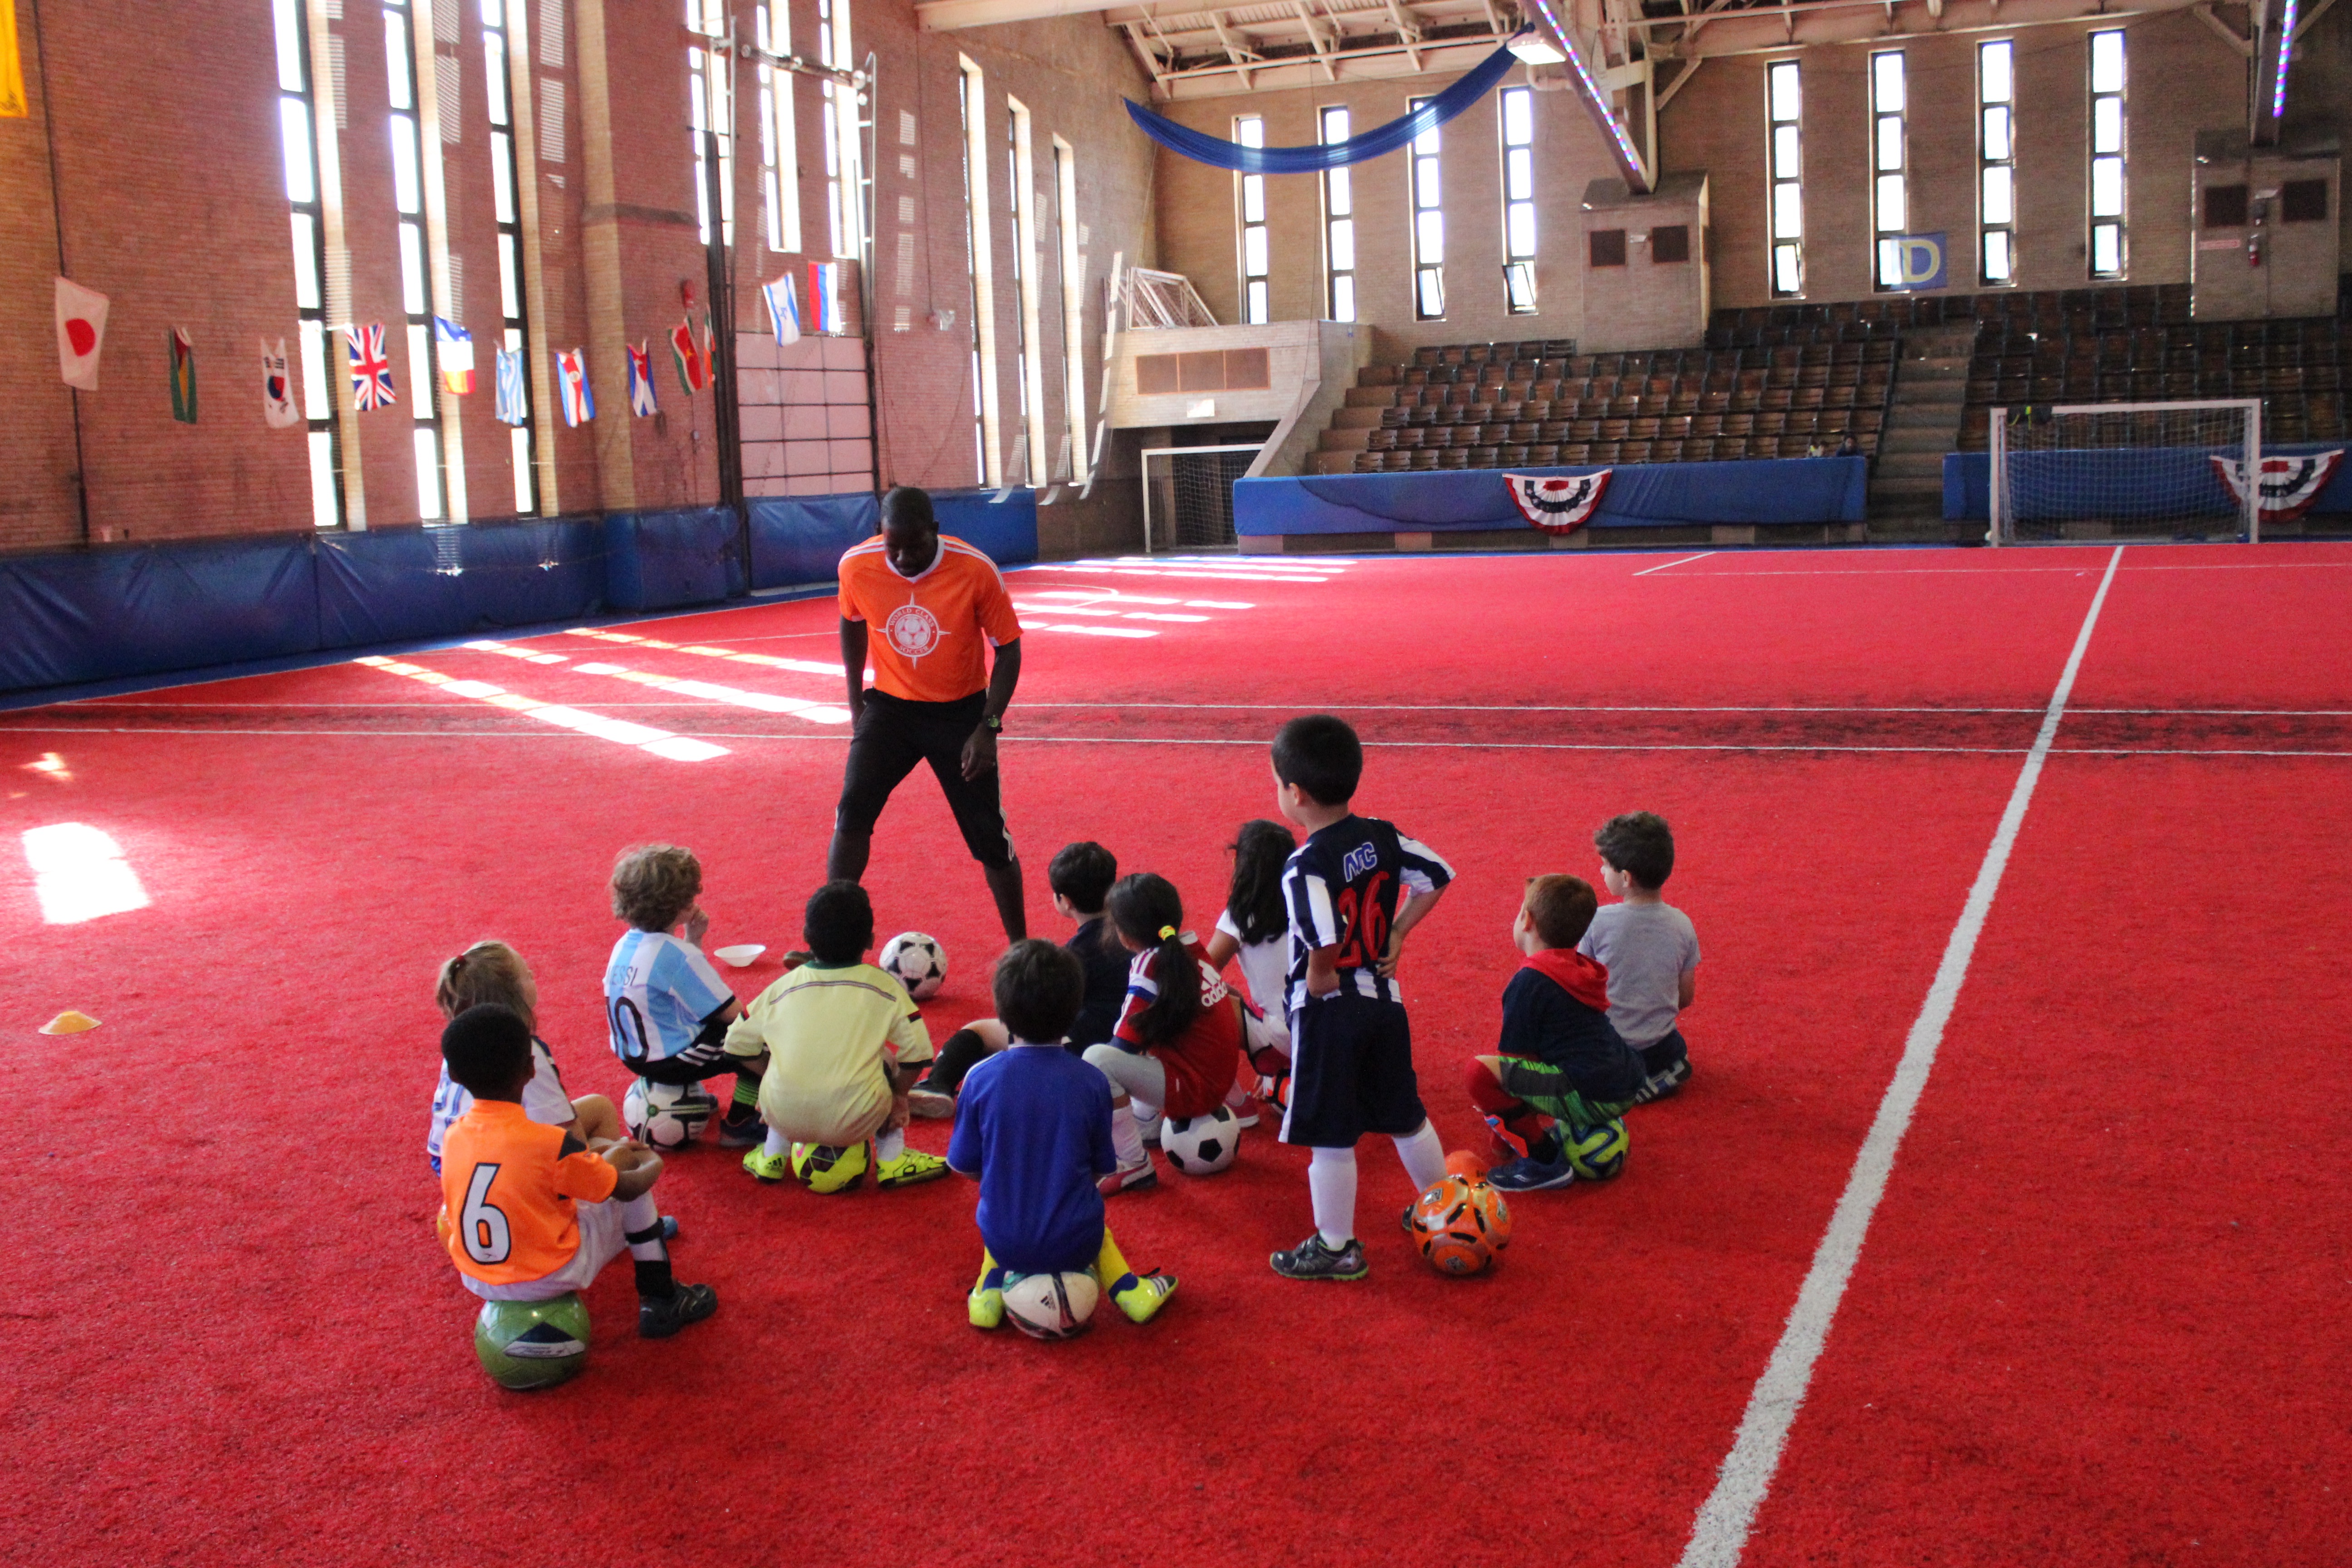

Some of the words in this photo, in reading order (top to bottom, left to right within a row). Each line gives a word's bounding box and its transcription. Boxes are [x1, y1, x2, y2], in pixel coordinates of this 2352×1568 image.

[1899, 239, 1940, 284] D
[889, 608, 912, 626] WORLD
[915, 609, 935, 627] CLASS
[899, 645, 930, 654] SOCCER
[1334, 870, 1390, 968] 26
[1201, 981, 1228, 1007] adida
[605, 996, 649, 1063] 10
[460, 1162, 511, 1265] 6
